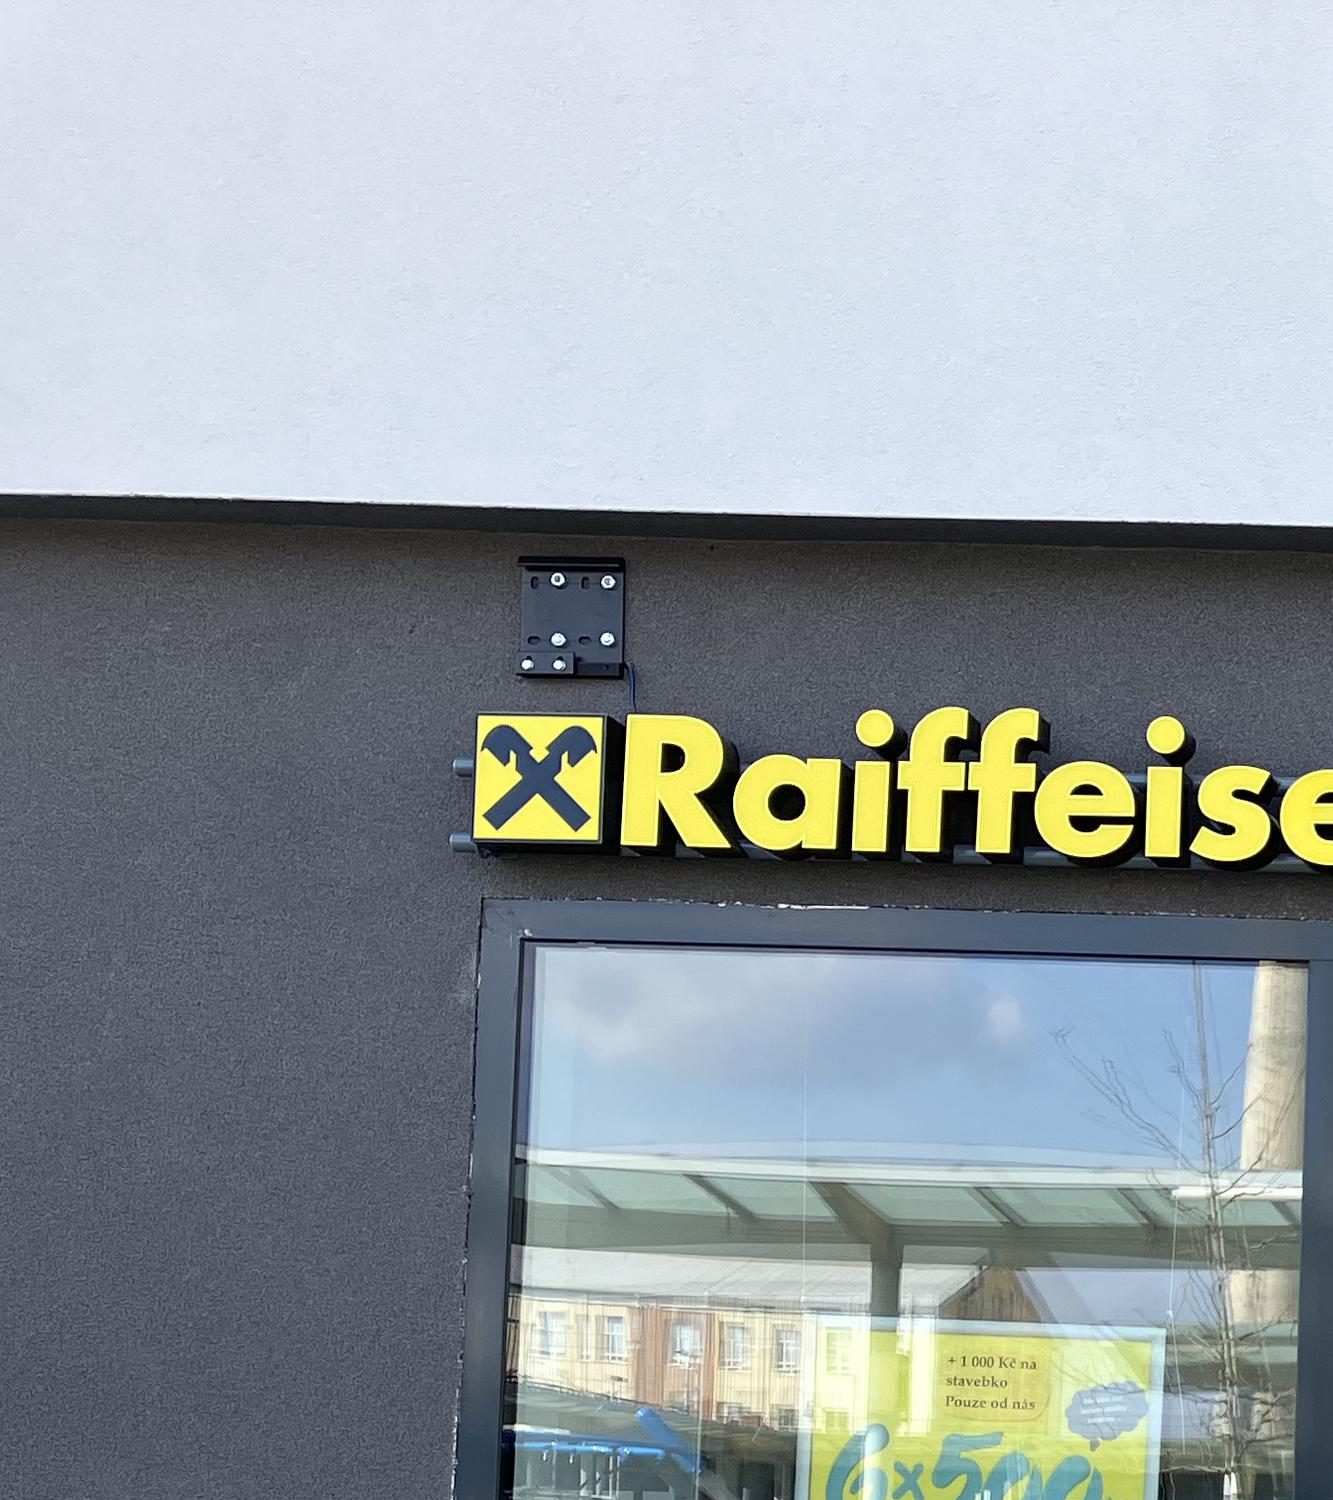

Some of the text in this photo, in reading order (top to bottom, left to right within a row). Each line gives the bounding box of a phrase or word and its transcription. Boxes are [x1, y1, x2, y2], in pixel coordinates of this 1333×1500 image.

[972, 1356, 995, 1368] 000
[999, 1356, 1016, 1369] Kč
[1021, 1360, 1037, 1370] na
[946, 1375, 1008, 1388] stavebko
[945, 1395, 1036, 1410] Pouze od nás
